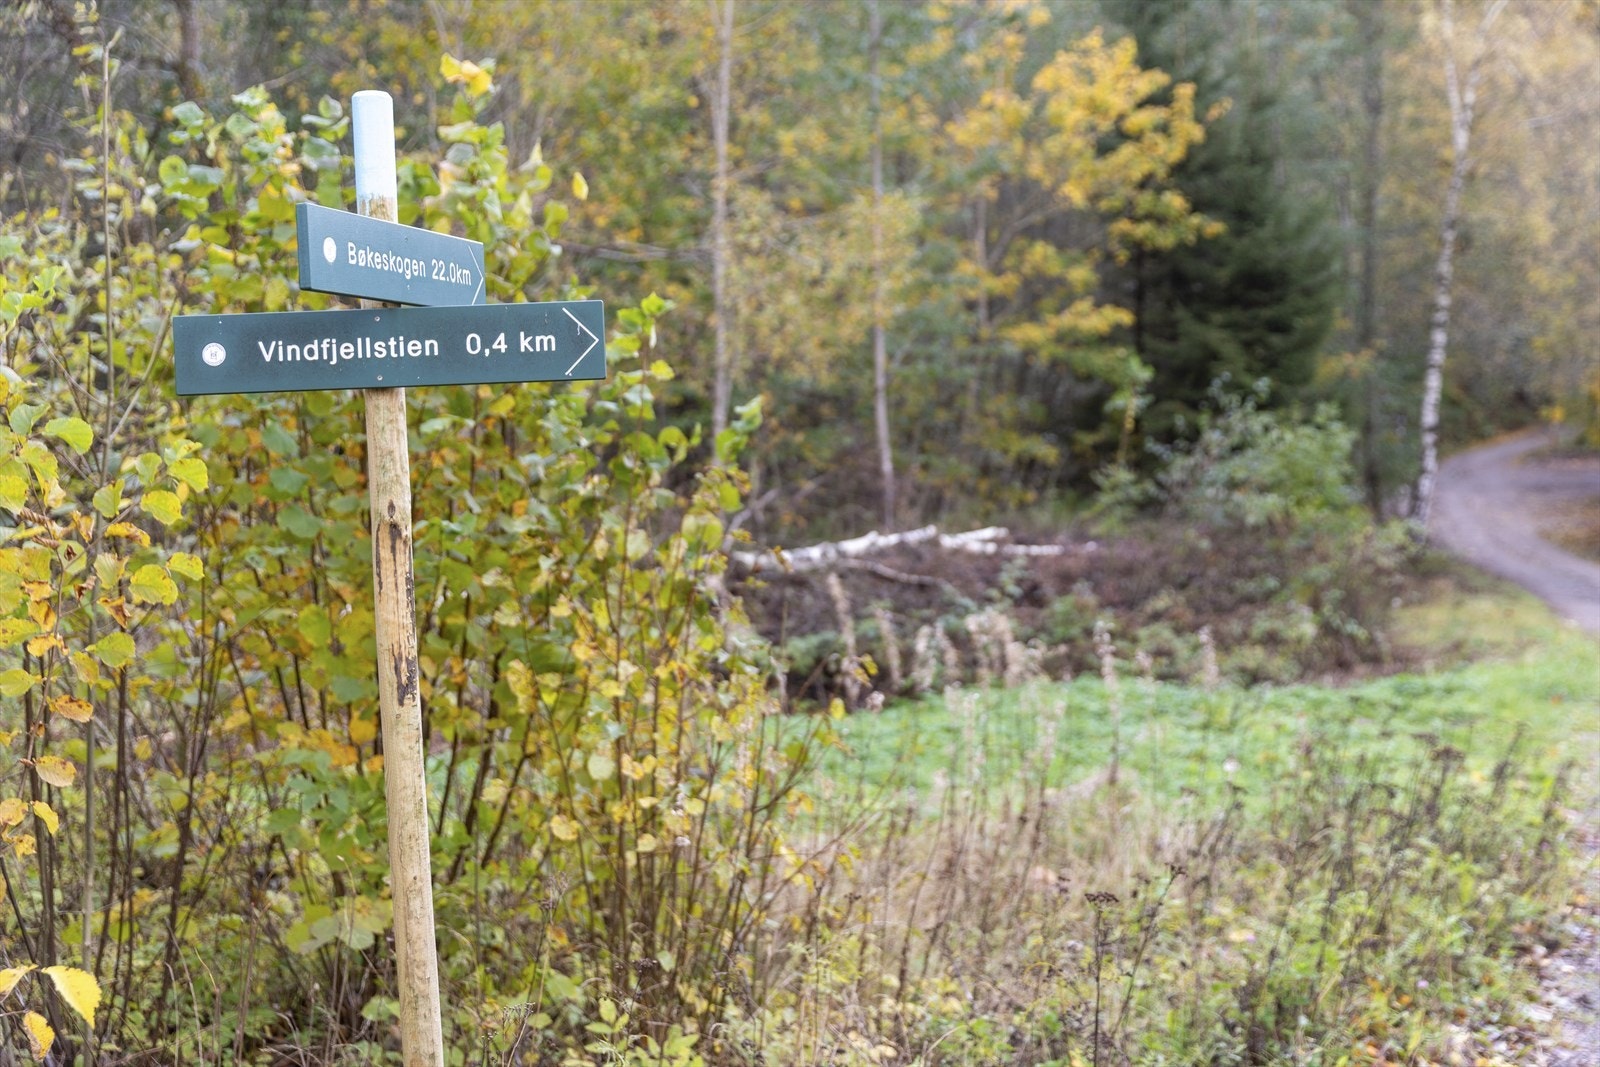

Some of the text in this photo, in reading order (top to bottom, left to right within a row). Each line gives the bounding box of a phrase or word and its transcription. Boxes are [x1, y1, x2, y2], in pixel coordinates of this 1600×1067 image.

[347, 241, 472, 286] Bøkeskogen 22.0km
[257, 337, 439, 366] Vindfjellstien
[465, 332, 509, 359] 0,4
[519, 330, 557, 354] km
